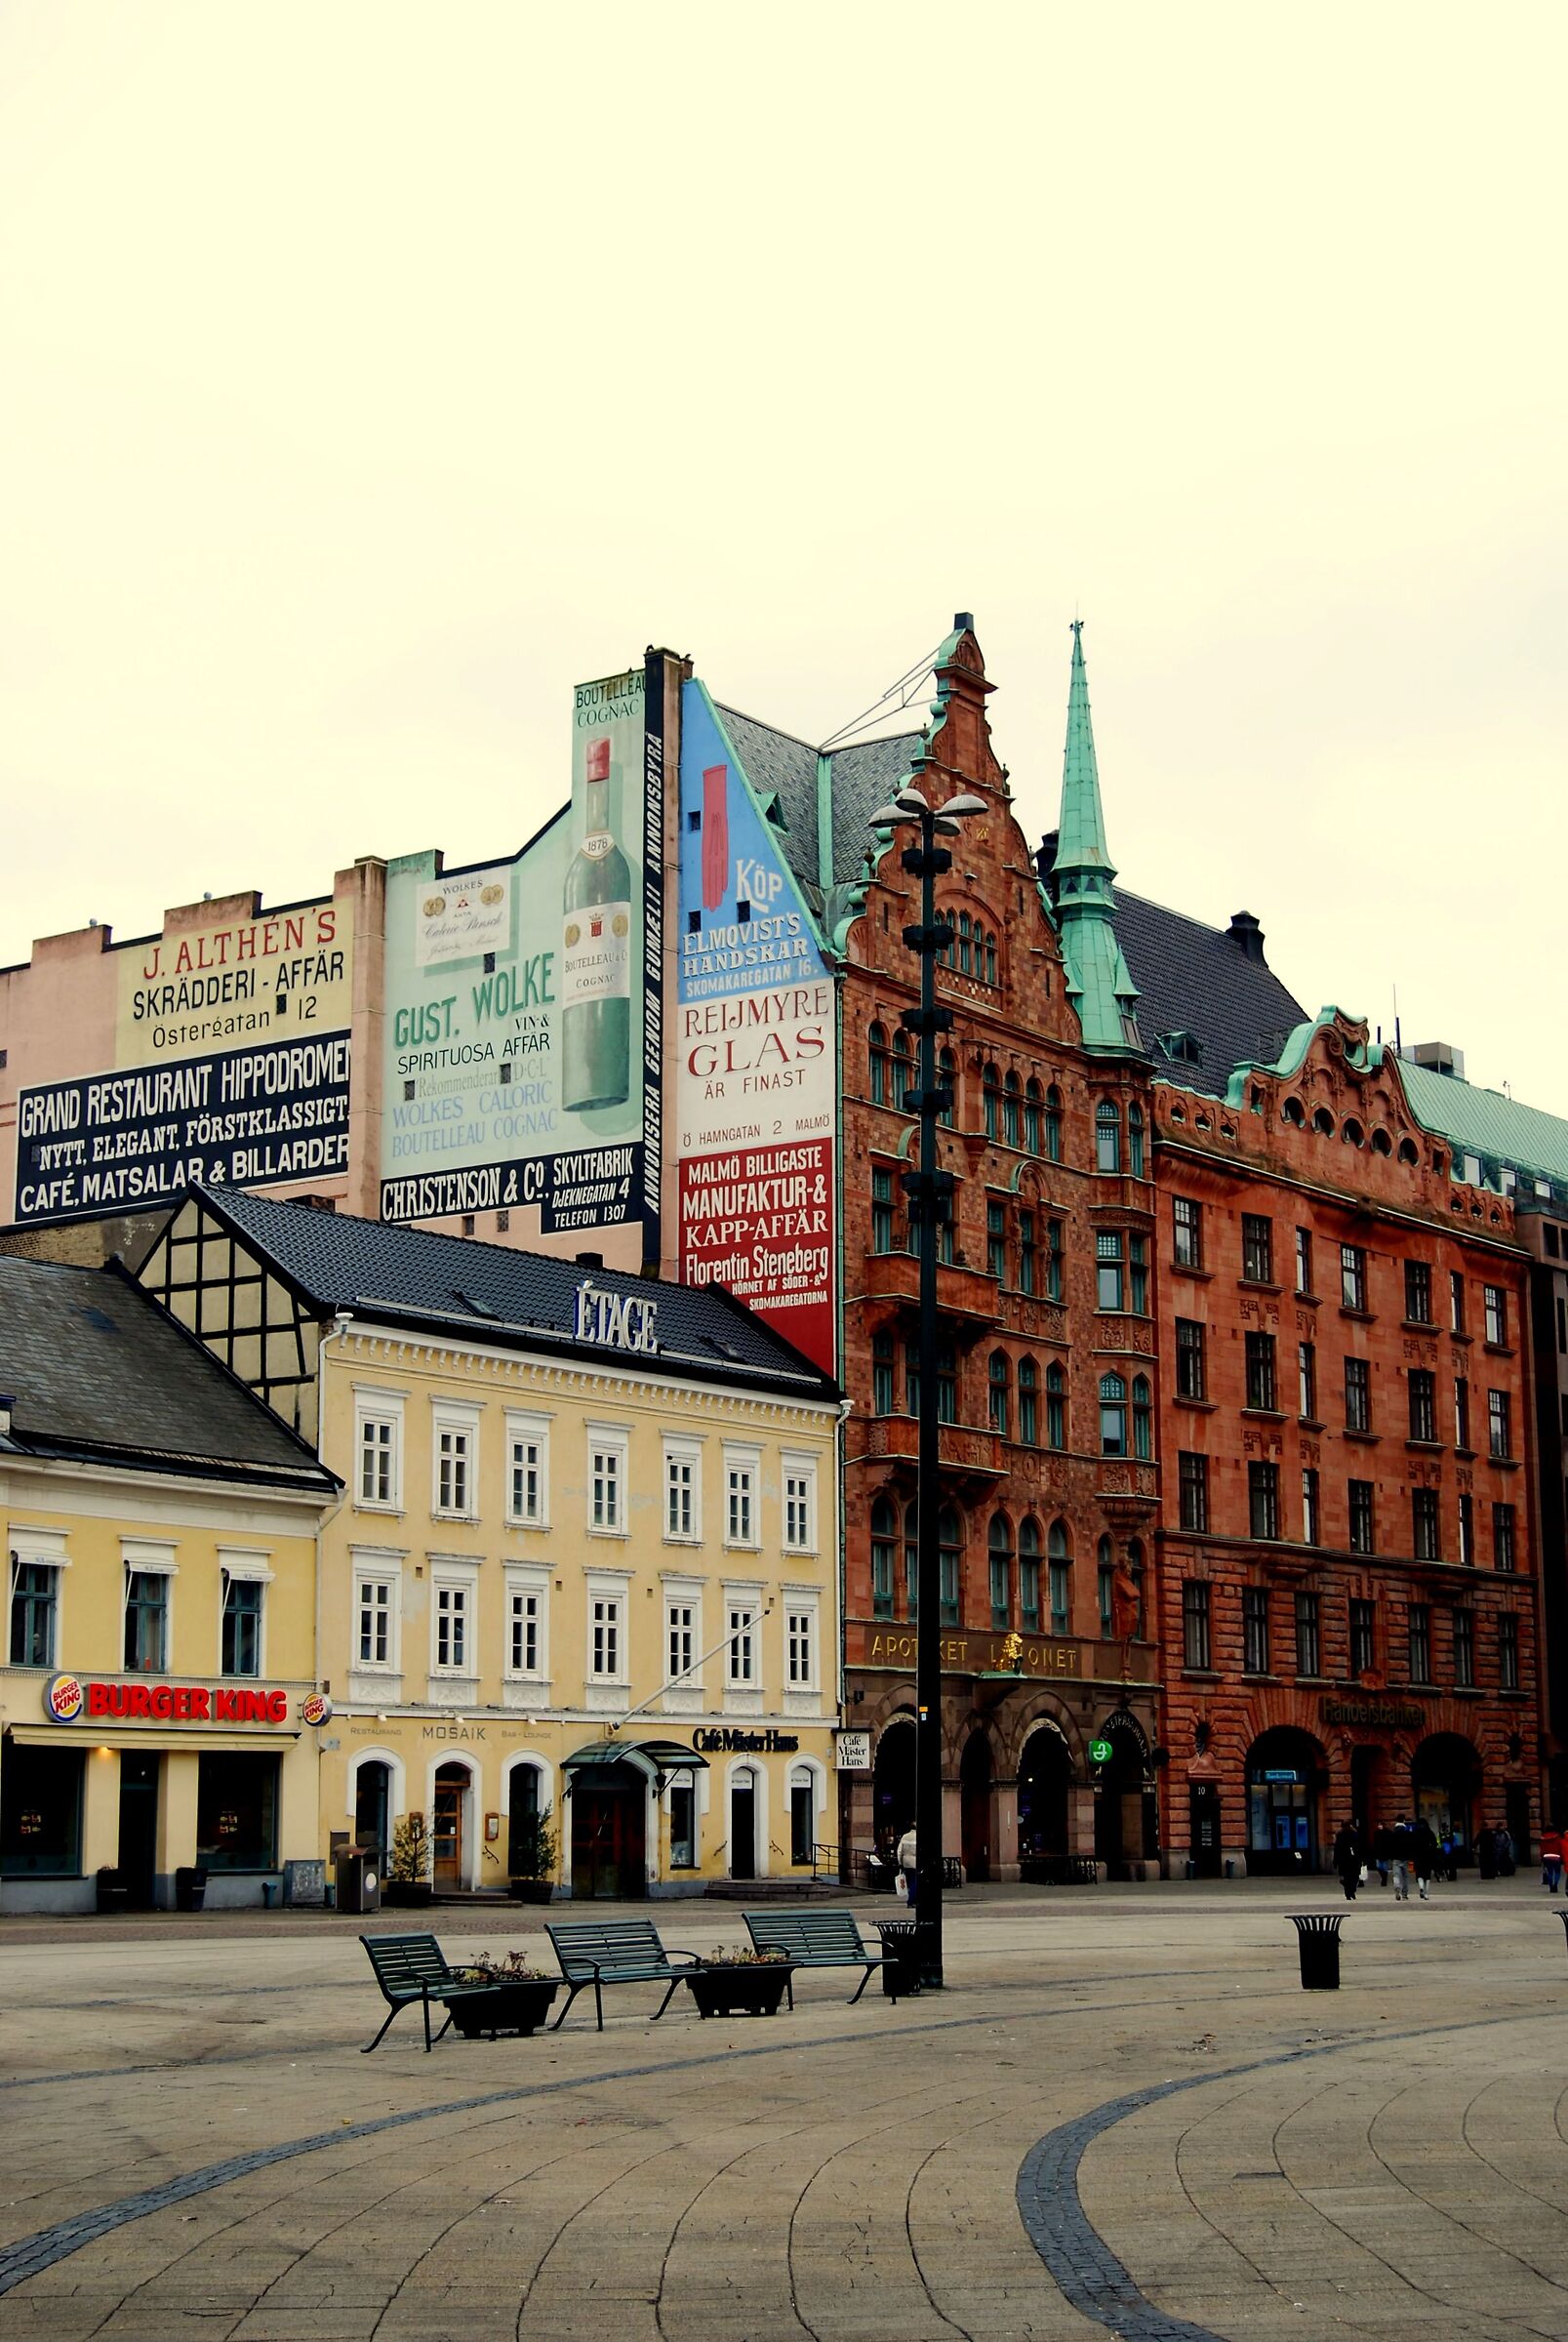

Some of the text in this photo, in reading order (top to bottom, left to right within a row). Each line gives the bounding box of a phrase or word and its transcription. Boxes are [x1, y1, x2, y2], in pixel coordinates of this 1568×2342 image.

[578, 699, 639, 727] COGNAC
[647, 732, 663, 873] ANNONSBYRÅ
[587, 838, 607, 852] 1878
[443, 879, 483, 895] WOLKES
[736, 859, 784, 913] KÖP
[143, 908, 336, 980] J. ALTHÉN'S
[565, 952, 615, 973] BOUTELLEAU
[683, 937, 808, 978] HANDSKAR
[134, 968, 256, 1021] SKRÄDDERI
[276, 950, 343, 992] AFFÄR
[576, 975, 615, 989] COGNAC
[687, 963, 790, 997] SKOMAKAREGATAN
[394, 952, 556, 1049] GUST. WOLKE
[541, 1014, 549, 1027] &
[685, 987, 828, 1038] REIJMYRE
[153, 995, 317, 1049] Östergatan 12
[644, 989, 662, 1075] GENOM
[397, 1031, 550, 1074] SPIRITUOSA AFFÄR
[687, 1026, 826, 1078] GLAS
[20, 1089, 80, 1139] GRAND
[87, 1064, 213, 1126] RESTAURANT
[393, 1081, 553, 1128] WOLKES CALORIC
[704, 1070, 806, 1100] ÄR FINAST
[38, 1144, 87, 1170] NYTT,
[92, 1124, 180, 1162] ELEGANT,
[392, 1109, 558, 1157] BOUTELLEAU COGNAC
[644, 1085, 661, 1214] ANNONSERA
[699, 1124, 760, 1146] HAMNGATAN
[772, 1120, 783, 1135] 2
[795, 1113, 830, 1131] MALMÖ
[20, 1132, 349, 1213] CAFÉ, MATSALAR & BILLARDER
[553, 1148, 633, 1186] SKYLTFABRIK
[688, 1146, 823, 1186] MALMÖ BILLIGASTE
[382, 1169, 501, 1221] CHRISTENSON
[503, 1169, 518, 1203] &
[552, 1177, 630, 1208] DJEKNEGATAN 4
[554, 1204, 626, 1228] TELEFON 1307
[686, 1209, 828, 1249] KAPP-AFFÄR
[686, 1242, 828, 1285] Florentin Steneberg
[732, 1279, 763, 1295] HÖRNET
[767, 1279, 778, 1291] AF
[749, 1290, 827, 1311] SKOMAKAREGATORNA
[575, 1280, 658, 1354] ÉTAGE
[53, 1680, 78, 1702] BURGER
[55, 1689, 81, 1714] KING
[88, 1681, 288, 1723] BURGER KING
[304, 1697, 323, 1712] BURGER
[304, 1704, 324, 1717] KING
[693, 1727, 798, 1753] Café Mäster Hans
[838, 1746, 866, 1756] Mäster
[843, 1735, 861, 1747] Café
[841, 1756, 863, 1766] Hans
